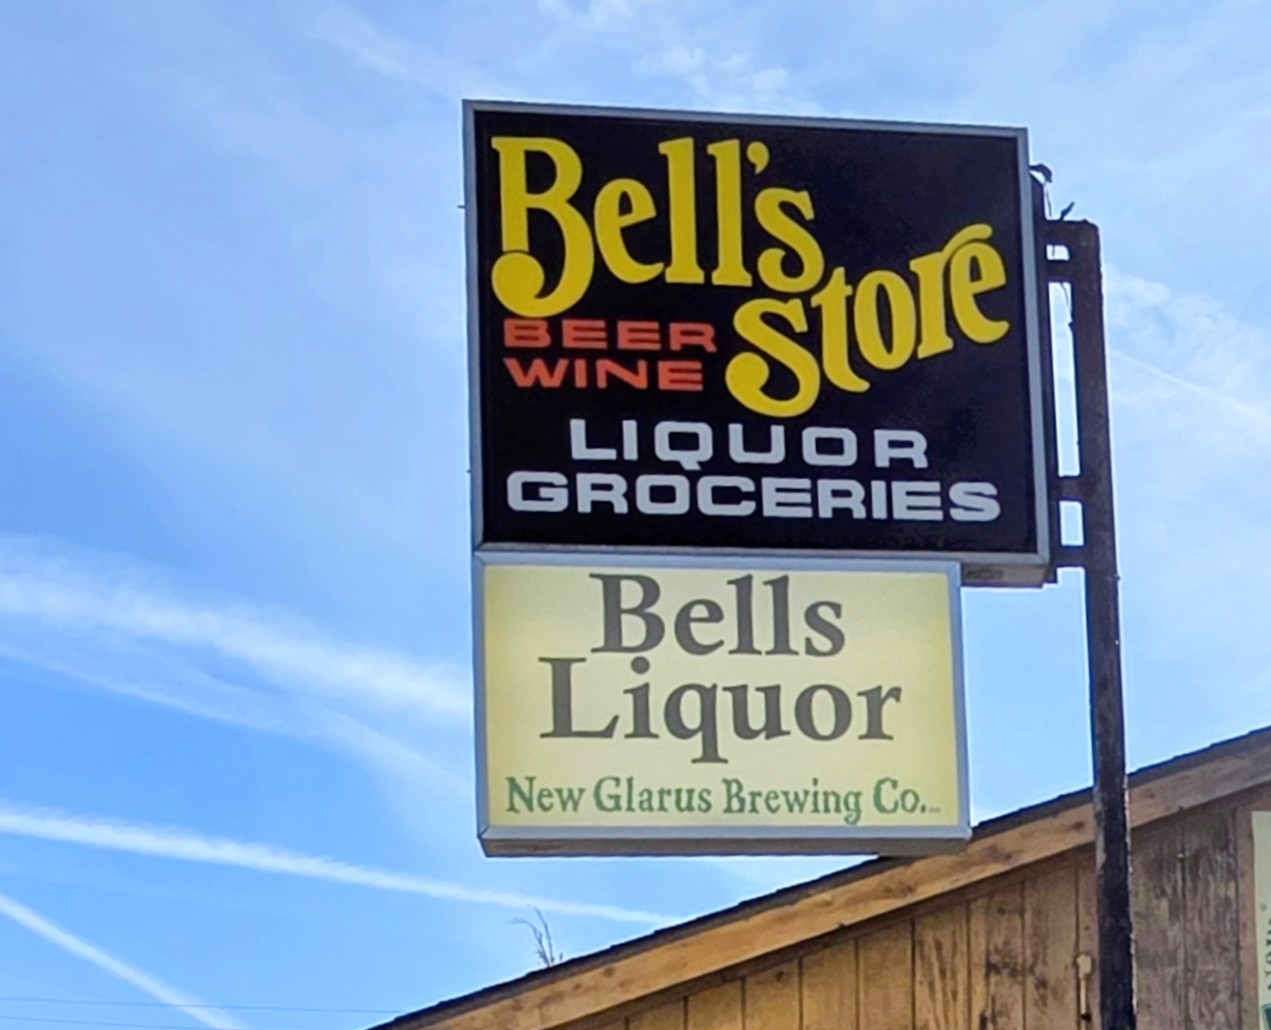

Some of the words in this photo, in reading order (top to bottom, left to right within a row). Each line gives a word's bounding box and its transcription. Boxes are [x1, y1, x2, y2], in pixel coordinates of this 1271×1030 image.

[491, 137, 824, 317] Bell's
[504, 319, 717, 352] BEER
[725, 223, 1010, 417] Store
[503, 358, 704, 391] WINE
[569, 418, 928, 469] LIQUOR
[507, 470, 1000, 521] GROCERIES
[589, 573, 845, 657] Bells
[538, 657, 902, 764] Liquor
[506, 777, 586, 813] New
[593, 776, 712, 813] Glarus
[722, 778, 861, 824] Brewing
[873, 778, 927, 813] Co.
